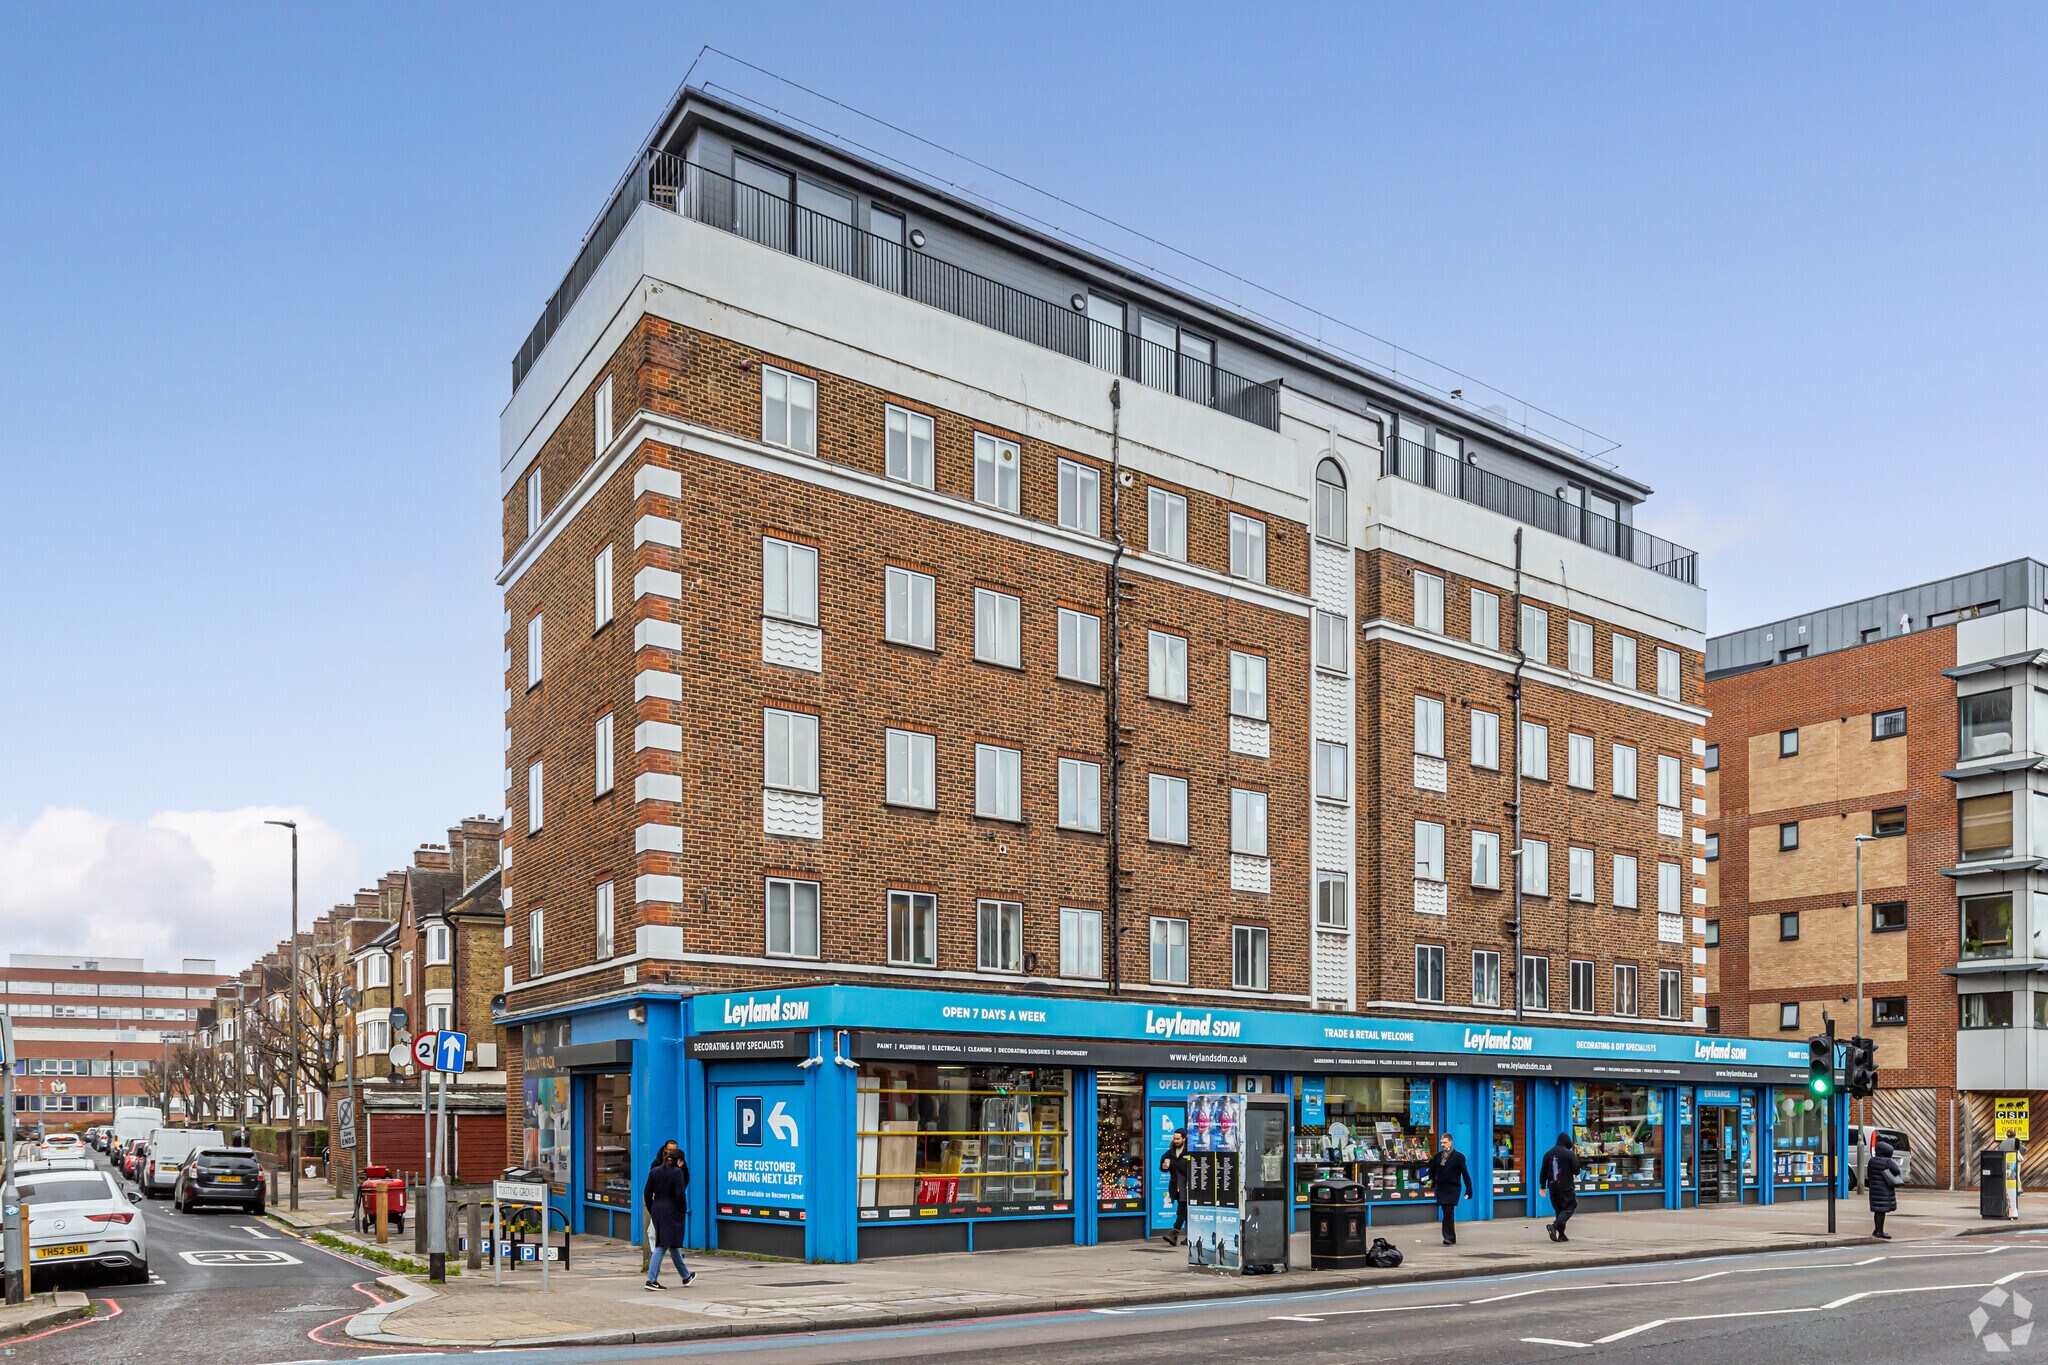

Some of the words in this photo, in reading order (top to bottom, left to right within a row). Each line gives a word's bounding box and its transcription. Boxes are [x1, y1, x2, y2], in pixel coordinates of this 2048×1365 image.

[724, 995, 781, 1027] Leyland
[782, 1001, 809, 1020] SDM
[942, 1006, 971, 1018] OPEN
[973, 1007, 979, 1019] 7
[981, 1008, 1007, 1021] DAYS
[1008, 1010, 1016, 1021] A
[1018, 1010, 1047, 1023] WEEK
[1145, 1010, 1211, 1037] Leyland
[1212, 1020, 1240, 1037] SDM
[1324, 1028, 1348, 1039] TRADE
[1349, 1029, 1355, 1039] &
[1355, 1030, 1380, 1041] RETAIL
[1381, 1031, 1414, 1042] WELCOME
[1464, 1028, 1511, 1052] Leyland
[1512, 1036, 1532, 1051] SDM
[694, 1041, 730, 1051] DECORATING
[731, 1041, 735, 1051] &
[736, 1041, 746, 1050] DIY
[747, 1040, 784, 1050] SPECIALISTS
[899, 1043, 926, 1051] PLUMBING
[932, 1044, 962, 1052] ELECTRICAL
[1576, 1040, 1609, 1051] DECORATING
[1610, 1041, 1615, 1051] &
[1616, 1041, 1625, 1051] DIY
[1626, 1042, 1656, 1053] SPECIALISTS
[1695, 1040, 1731, 1061] Leyland
[1731, 1048, 1746, 1060] SDM
[1169, 1053, 1248, 1064] www.leylandsdm.co.uk
[1497, 1062, 1552, 1072] www.leylandsdm.co.uk
[1159, 1079, 1184, 1090] OPEN
[1186, 1080, 1191, 1090] 7
[1193, 1080, 1216, 1091] DAYS
[1248, 1080, 1253, 1088] P
[1704, 1090, 1731, 1098] ENTRANCE
[743, 1108, 755, 1134] P
[342, 1137, 355, 1146] ENDS
[734, 1160, 752, 1171] FREE
[754, 1161, 796, 1172] CUSTOMER
[728, 1171, 760, 1183] PARKING
[761, 1173, 781, 1184] NEXT
[784, 1174, 803, 1185] LEFT
[498, 1185, 518, 1196] TOOTING
[519, 1187, 534, 1197] GROVE
[41, 1247, 65, 1256] TH52
[67, 1245, 84, 1254] SHA
[482, 1241, 490, 1252] P
[502, 1245, 511, 1256] P
[194, 1252, 274, 1262] 20
[523, 1248, 533, 1259] P
